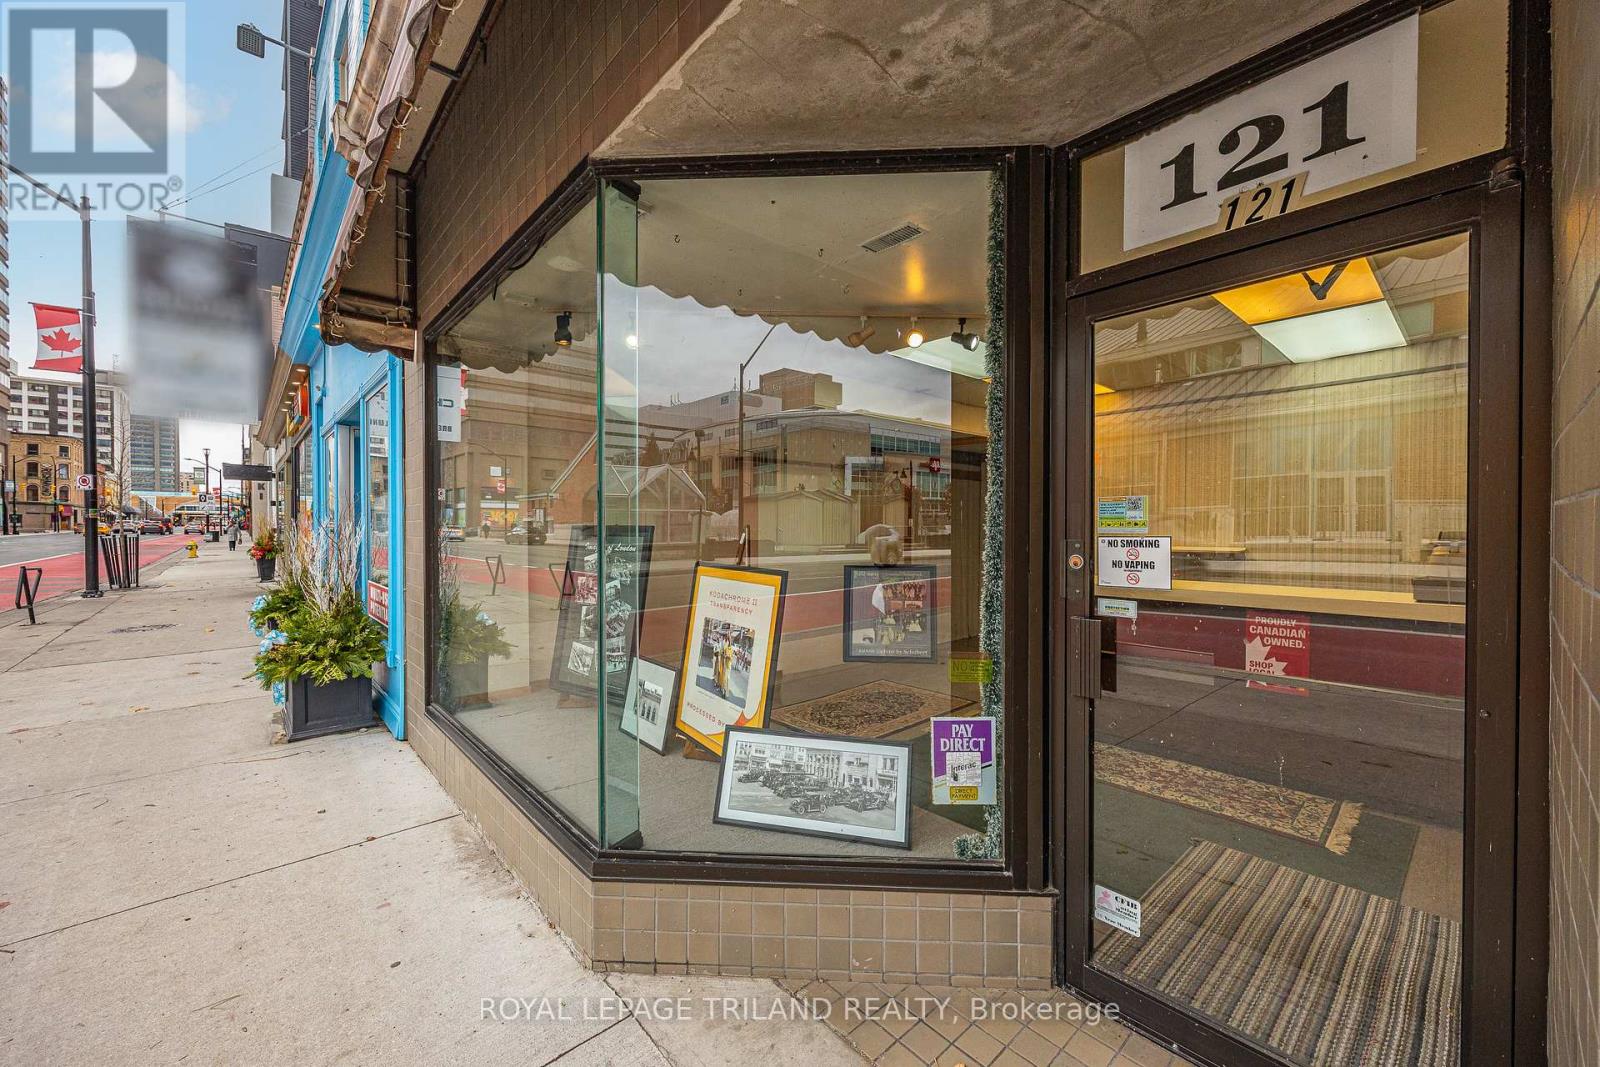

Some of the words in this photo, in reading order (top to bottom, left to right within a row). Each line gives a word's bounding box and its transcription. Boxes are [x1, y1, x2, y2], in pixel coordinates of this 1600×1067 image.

[1160, 80, 1366, 212] 121
[1225, 178, 1296, 231] 121
[614, 542, 637, 552] London
[1107, 539, 1118, 548] NO
[1120, 539, 1160, 549] SMOKING
[1111, 560, 1123, 569] NO
[1124, 560, 1155, 570] VAPING
[709, 590, 751, 605] KODACHROME
[710, 600, 753, 615] TRANSPARENCY
[1255, 616, 1297, 627] PROUDLY
[1249, 625, 1306, 639] CANADIAN
[1263, 637, 1306, 649] OWNED.
[952, 661, 968, 671] NO
[1249, 660, 1273, 669] SHOP
[687, 702, 716, 722] PROCESSED
[951, 723, 974, 738] PAY
[940, 737, 986, 752] DIRECT
